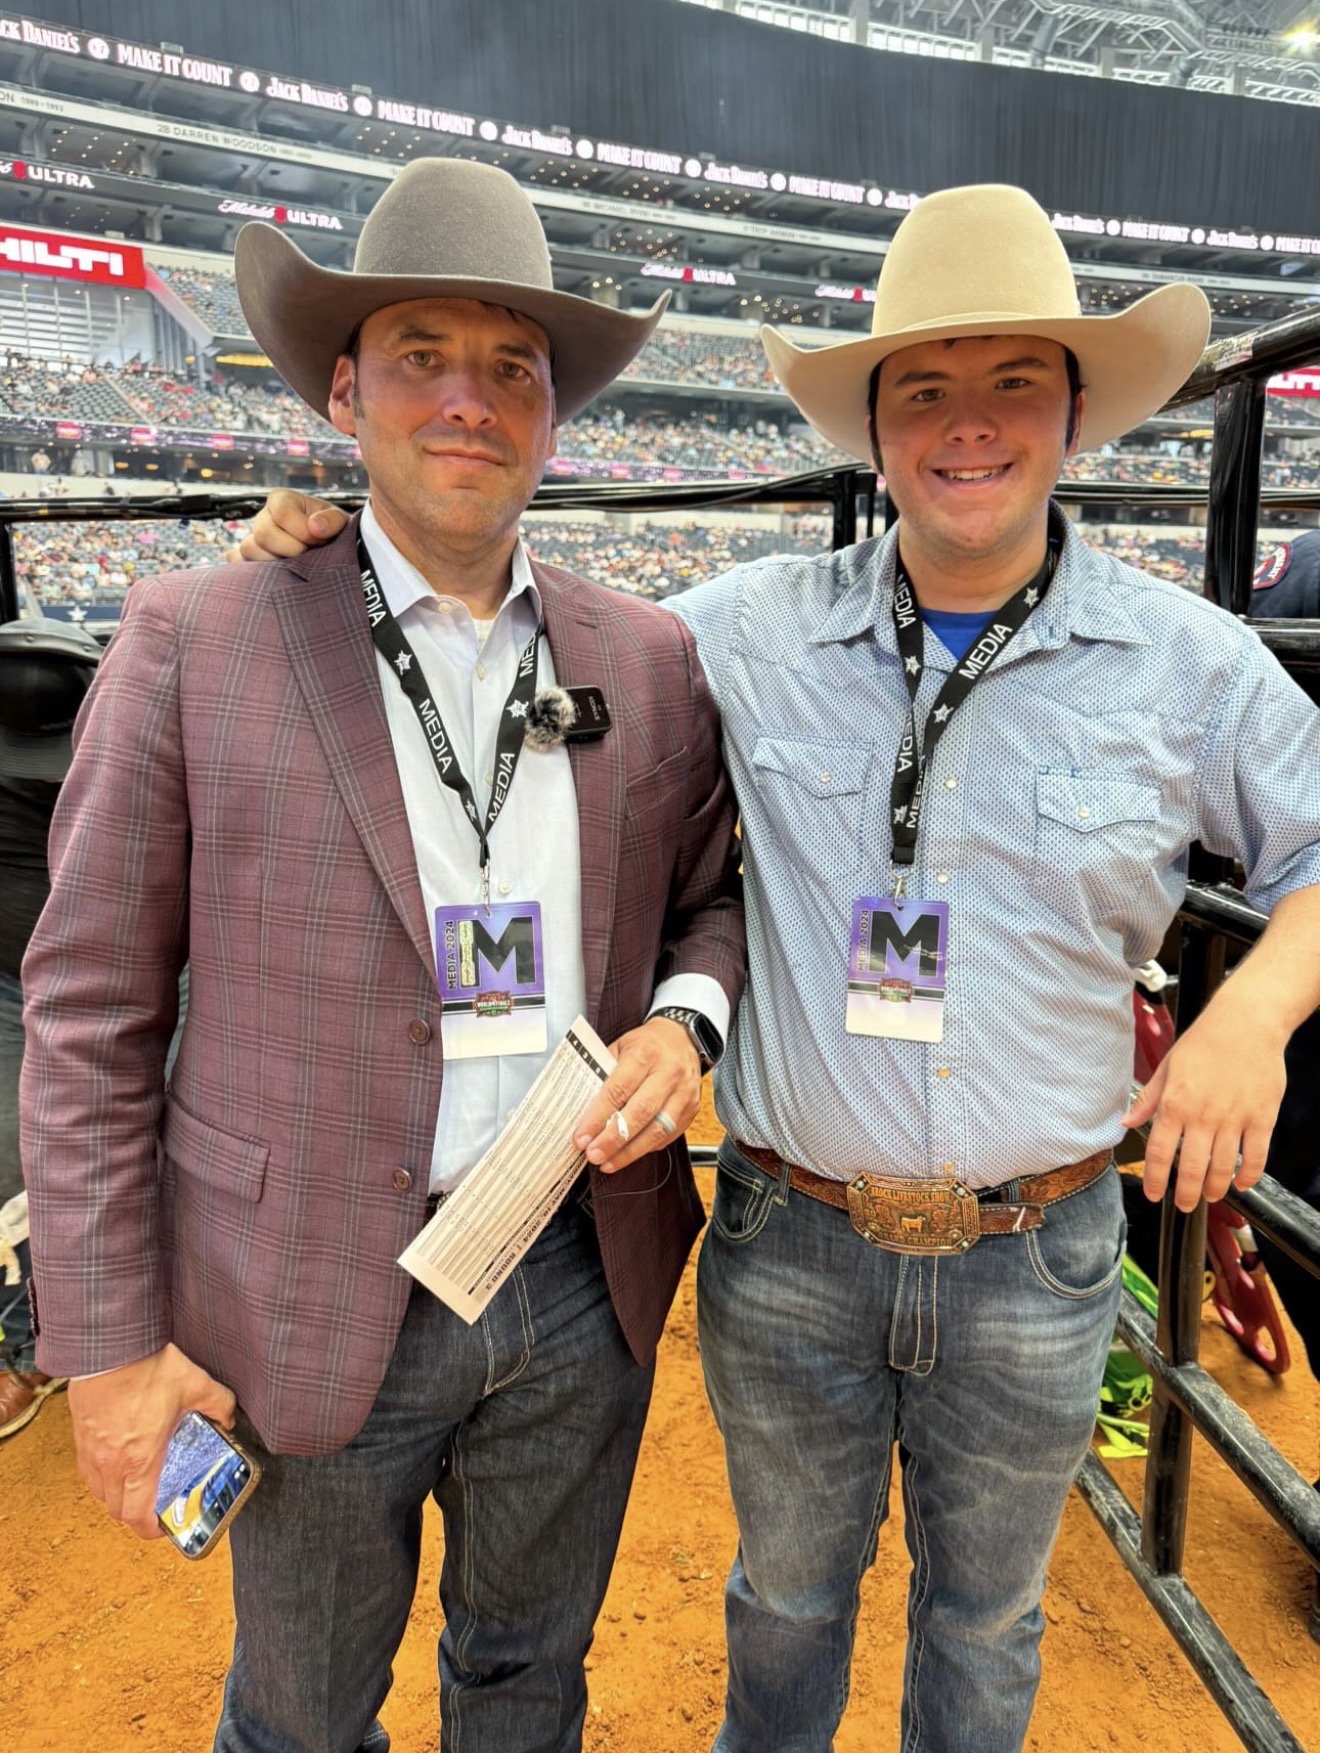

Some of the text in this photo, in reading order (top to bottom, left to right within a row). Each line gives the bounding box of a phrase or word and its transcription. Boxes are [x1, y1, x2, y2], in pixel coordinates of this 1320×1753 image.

[117, 43, 233, 87] MAKE IT COUNT
[173, 126, 219, 142] DARREN
[223, 136, 278, 154] WOODSON
[378, 100, 475, 136] MAKE IT COUNT
[28, 165, 95, 188] ULTRA
[286, 209, 343, 230] ULTRA
[361, 569, 387, 627] MEDIA
[519, 632, 536, 678] MED
[958, 622, 1013, 680] MEDIA
[419, 699, 452, 773] MEDIA
[897, 713, 913, 773] EDIA
[488, 751, 515, 823] MEDIA
[860, 910, 870, 936] 2024
[868, 911, 941, 977] M
[445, 920, 458, 990] MEDIA 2024
[457, 916, 537, 988] M
[893, 1190, 930, 1202] LIVESTOCK
[931, 1191, 950, 1203] SHOW
[523, 1220, 542, 1242] 2024
[908, 1236, 952, 1246] CHAMPION
[491, 1252, 516, 1284] ROUND
